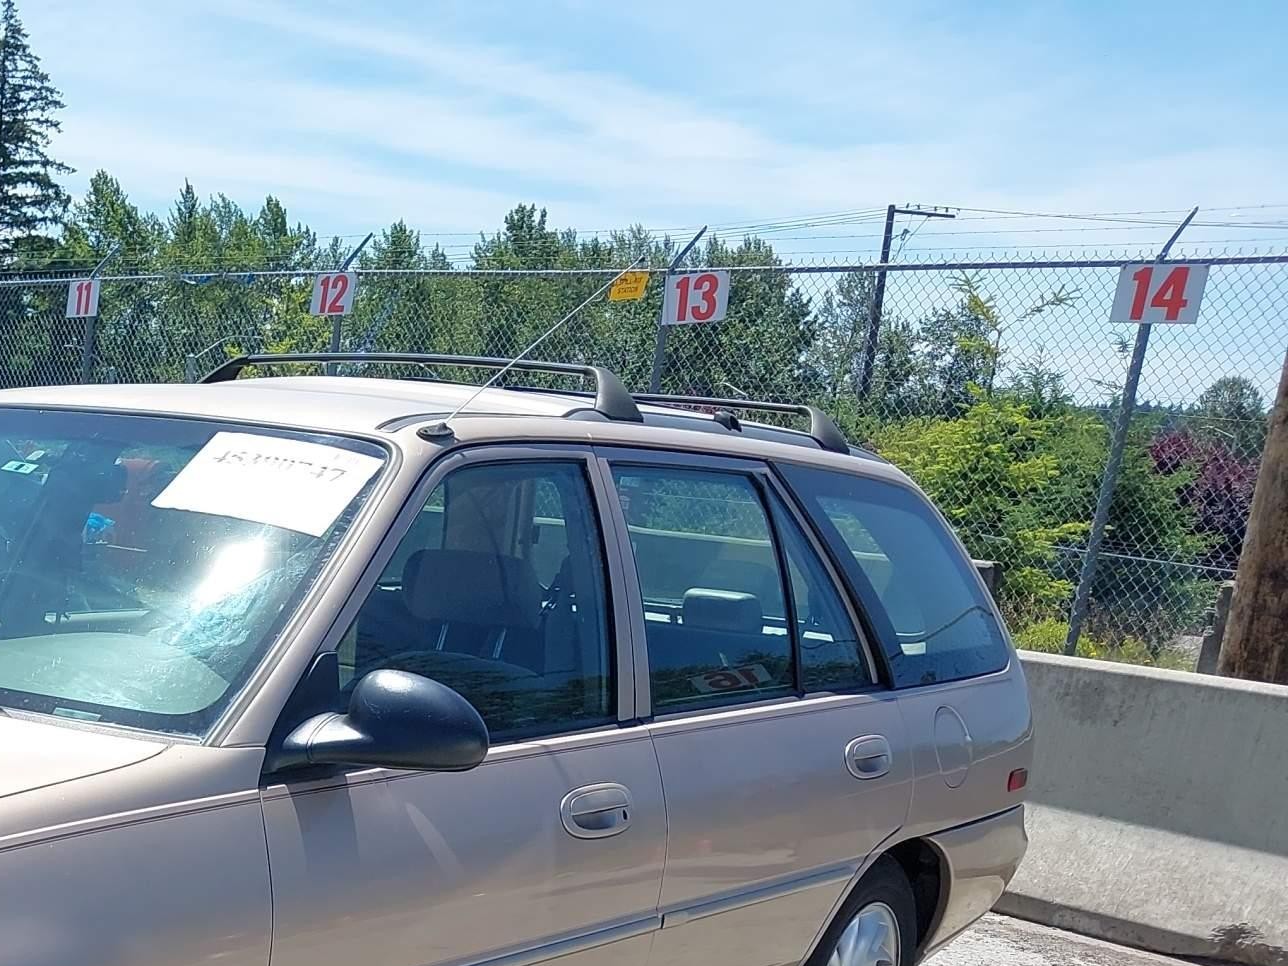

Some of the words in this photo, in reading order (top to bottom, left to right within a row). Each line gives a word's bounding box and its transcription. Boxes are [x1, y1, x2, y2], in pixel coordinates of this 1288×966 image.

[75, 281, 93, 315] 11
[319, 274, 349, 313] 12
[675, 273, 719, 322] 13
[1129, 267, 1191, 320] 14
